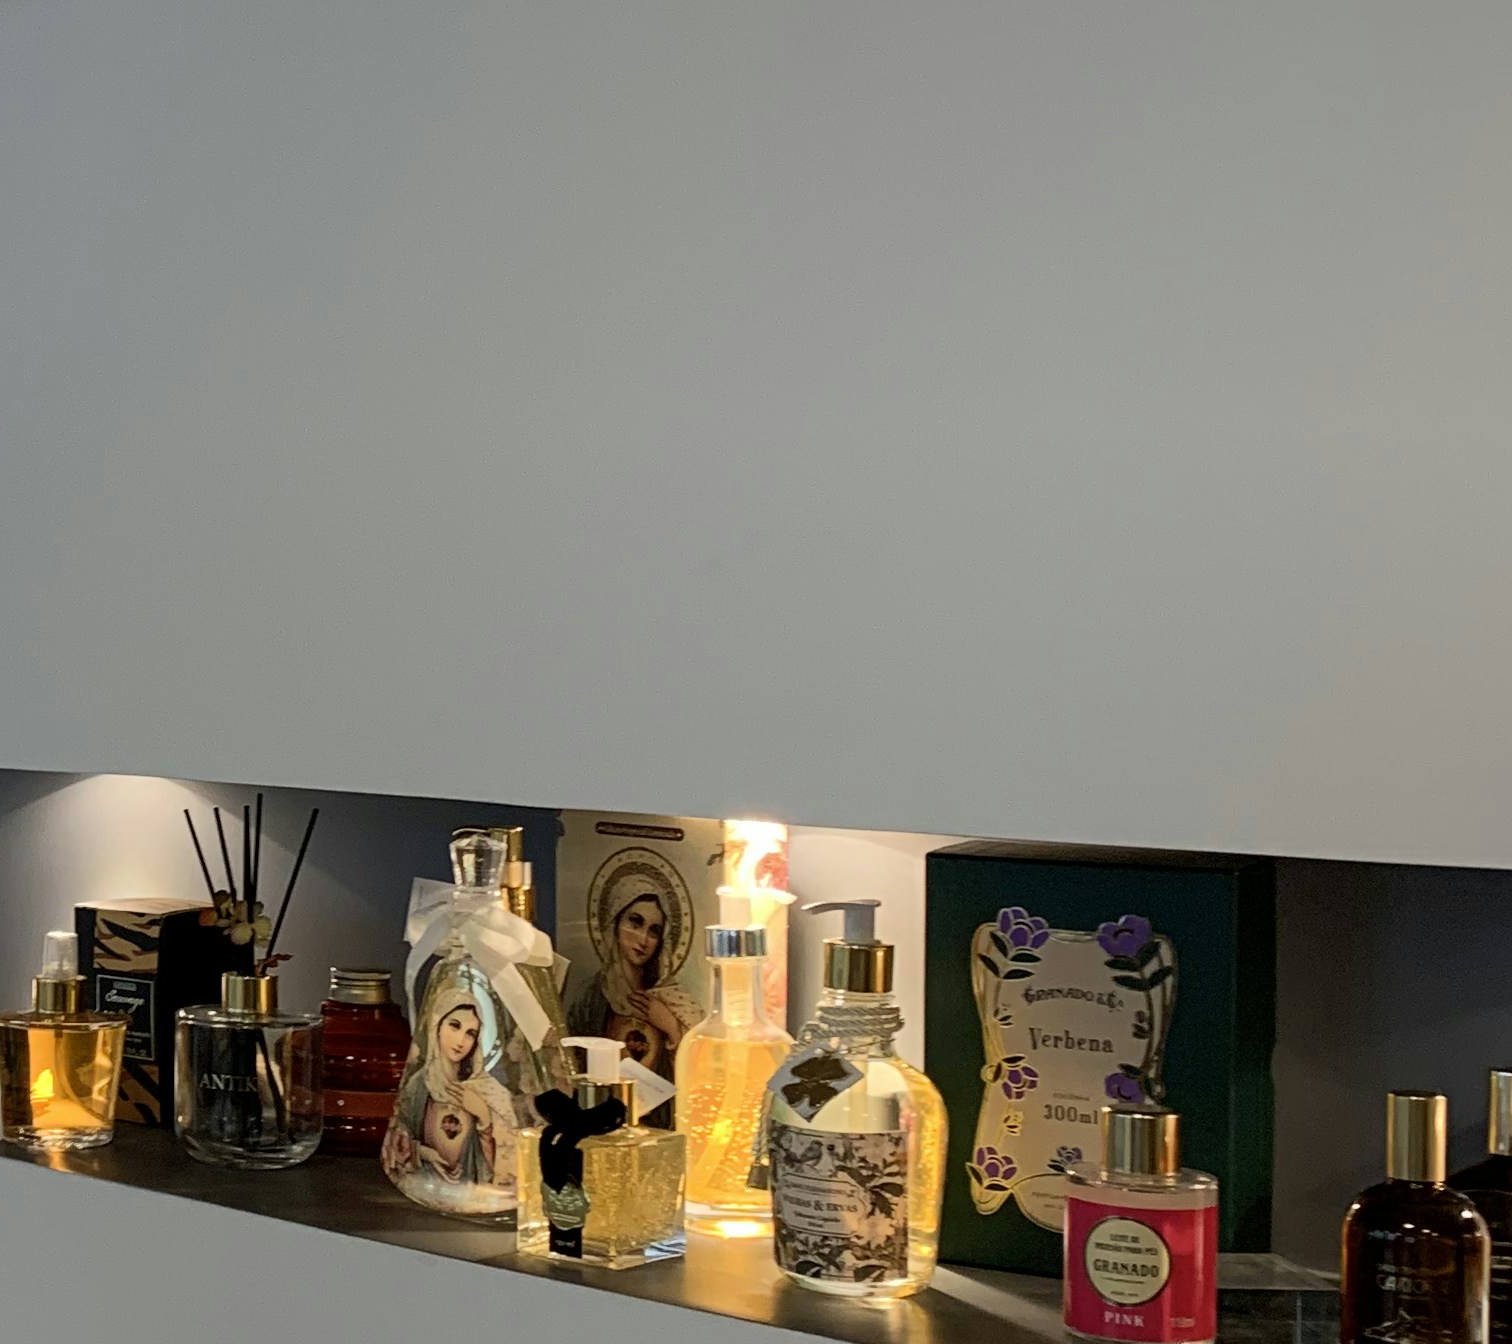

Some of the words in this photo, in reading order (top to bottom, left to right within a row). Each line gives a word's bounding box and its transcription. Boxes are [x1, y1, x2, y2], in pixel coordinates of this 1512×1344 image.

[1028, 1027, 1114, 1053] Verbena
[1043, 1104, 1099, 1125] 300ml
[1094, 1258, 1160, 1278] GRANADO
[1103, 1311, 1144, 1327] PINK
